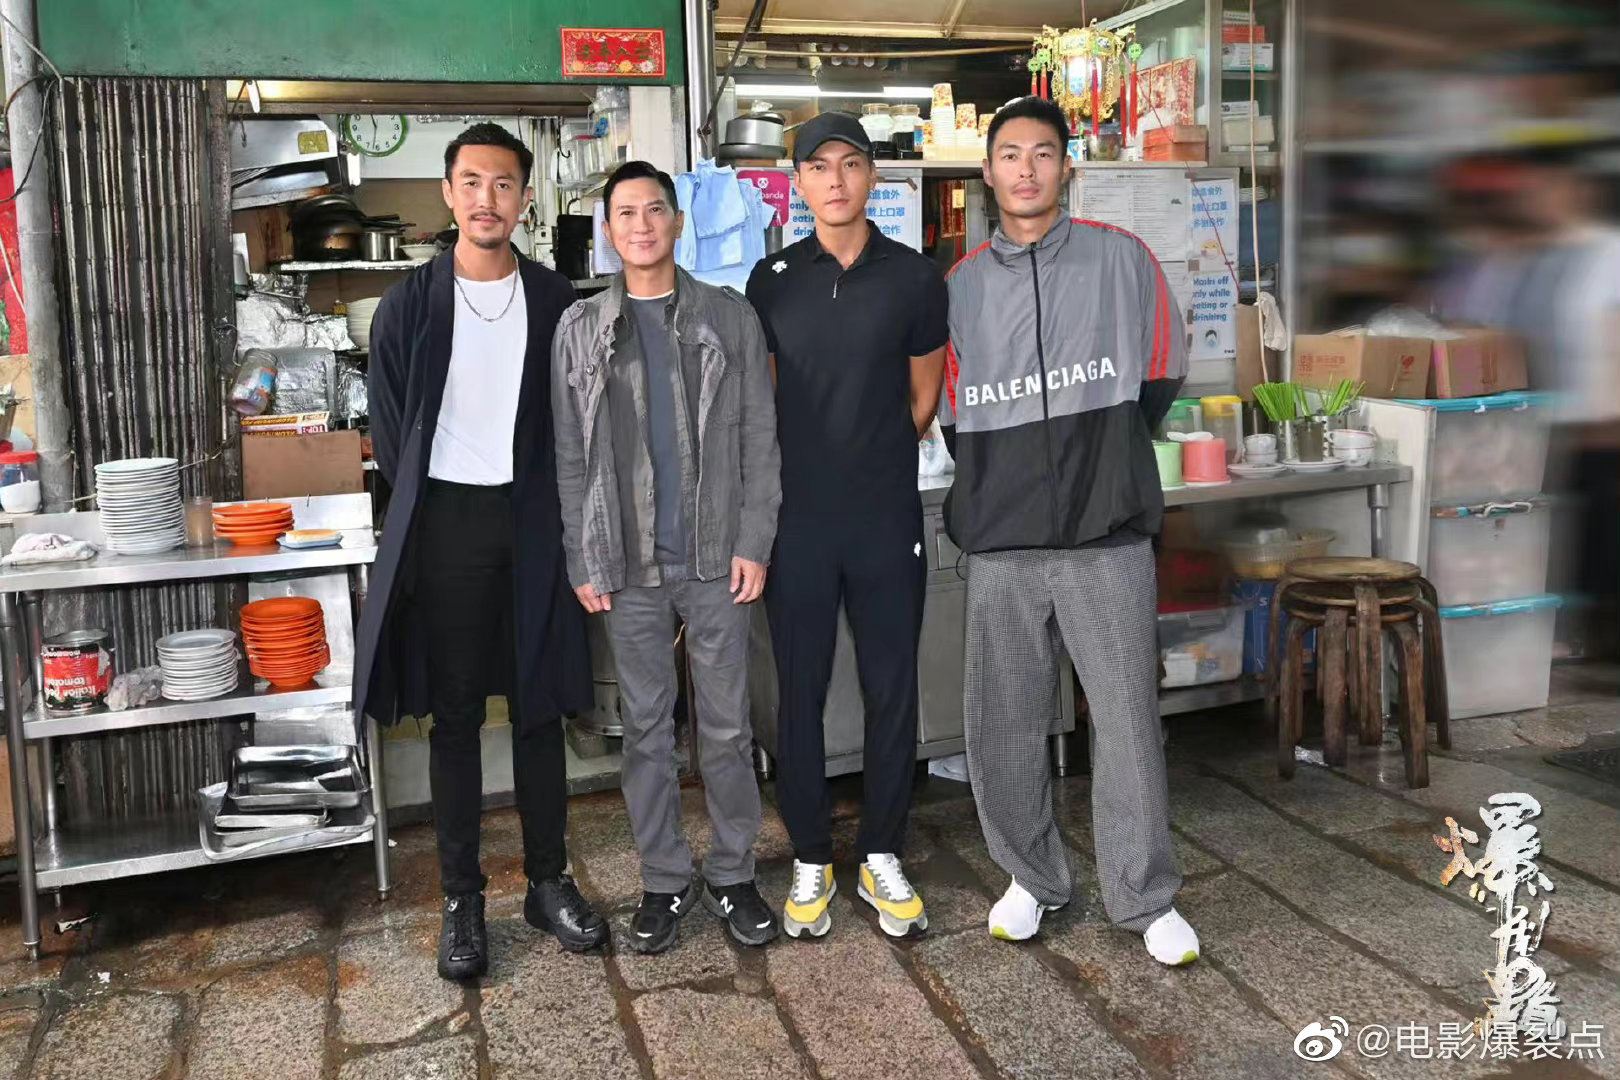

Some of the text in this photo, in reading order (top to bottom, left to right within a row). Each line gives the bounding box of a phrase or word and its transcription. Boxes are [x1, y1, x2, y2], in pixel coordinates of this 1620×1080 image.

[789, 200, 810, 211] only
[864, 206, 905, 217] 戴上口罩
[1217, 276, 1229, 285] off
[1209, 288, 1231, 298] while
[1220, 301, 1228, 309] or
[965, 357, 1117, 406] BALENCIAGA
